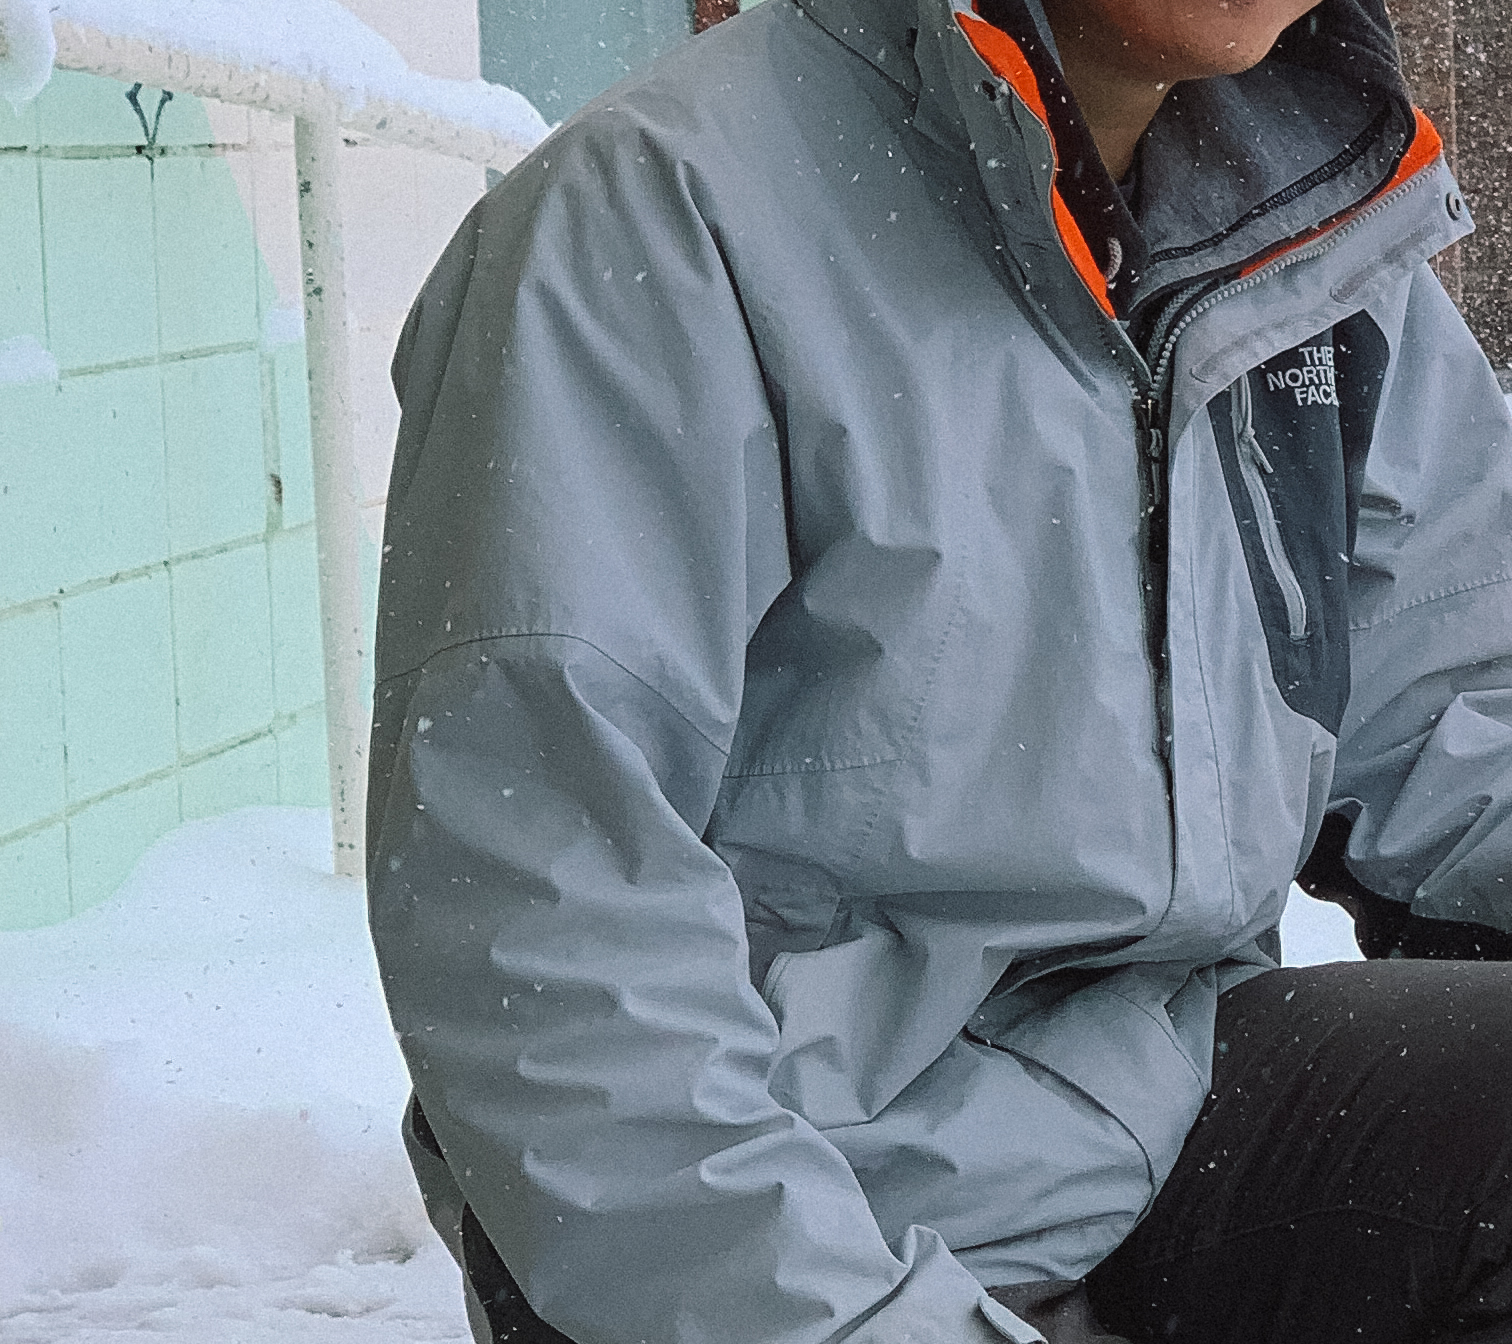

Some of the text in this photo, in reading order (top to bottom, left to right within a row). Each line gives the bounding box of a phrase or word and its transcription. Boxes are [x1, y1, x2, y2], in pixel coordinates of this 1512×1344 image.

[1299, 346, 1334, 366] THE
[1266, 366, 1336, 391] NORTH
[1294, 385, 1339, 407] FACE
